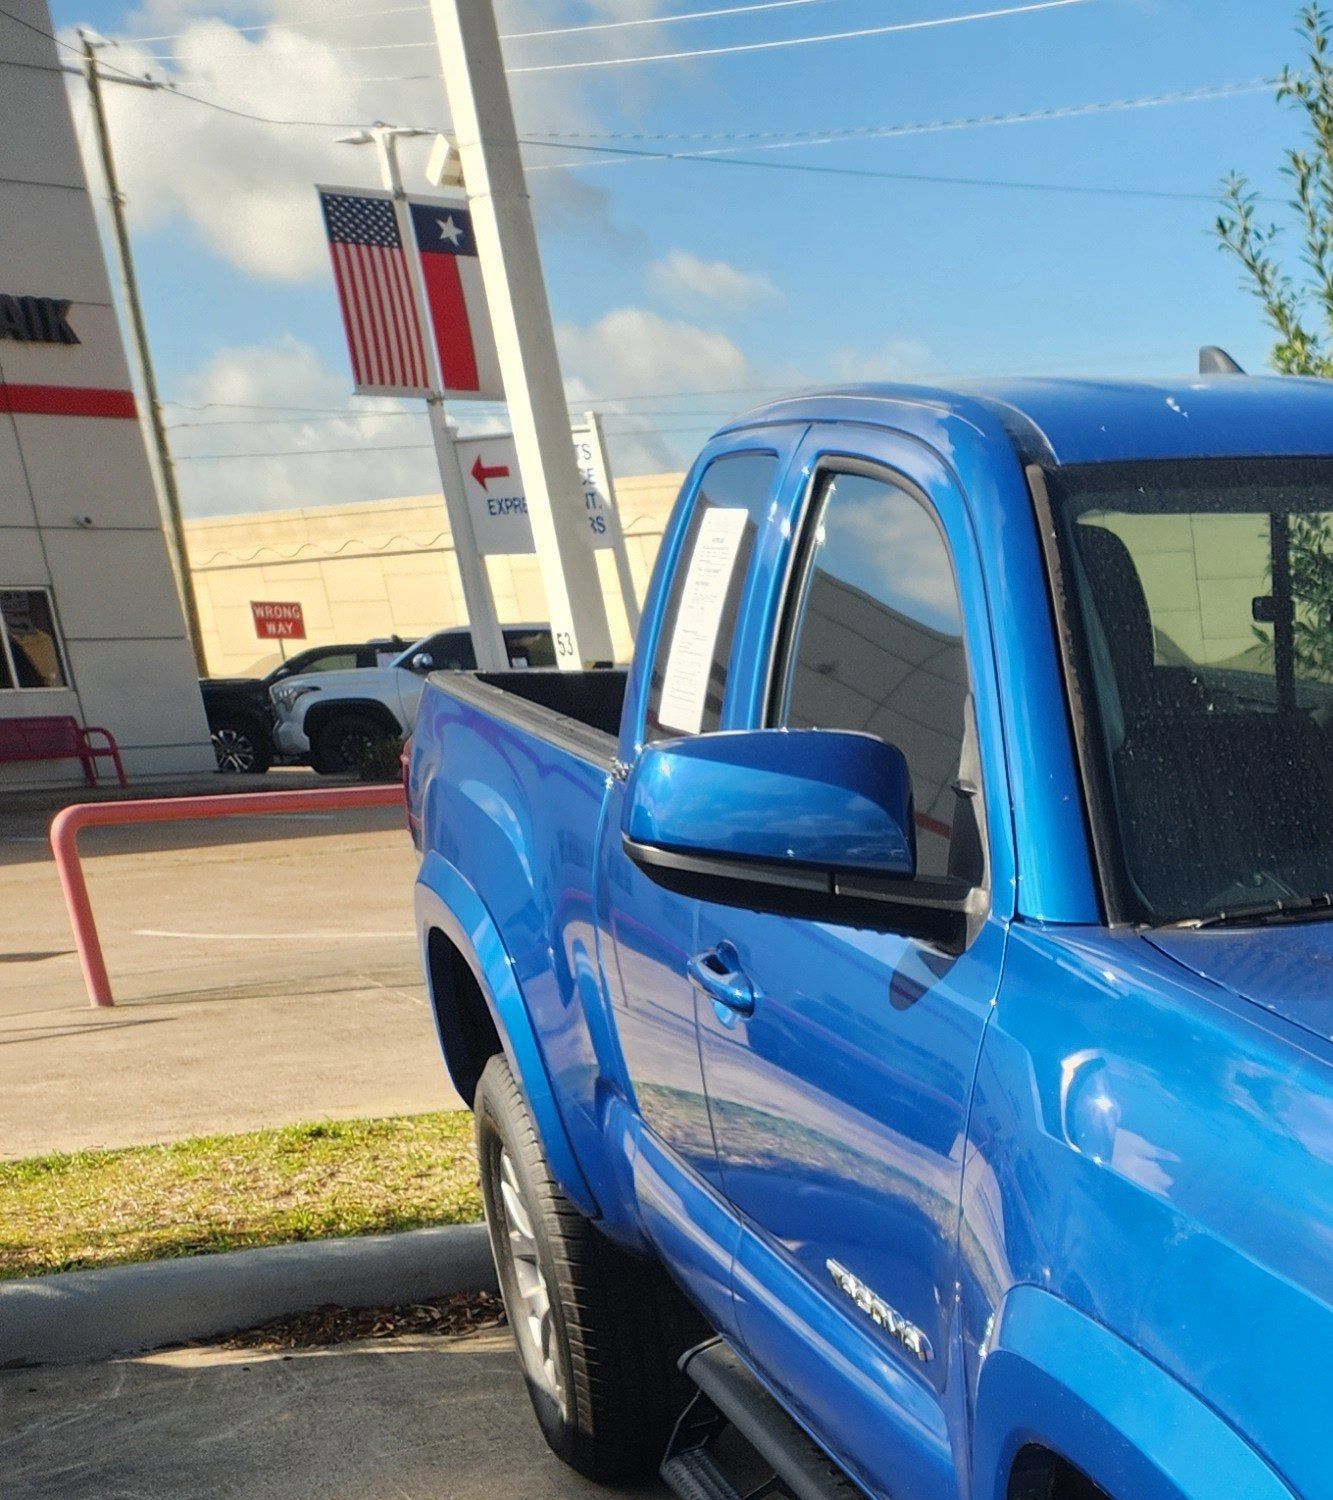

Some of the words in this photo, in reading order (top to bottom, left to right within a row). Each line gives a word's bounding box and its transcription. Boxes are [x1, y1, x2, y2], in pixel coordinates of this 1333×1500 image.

[487, 498, 528, 516] EXPRE
[253, 605, 300, 619] WRONG
[265, 621, 293, 635] WAY
[557, 632, 573, 656] 53
